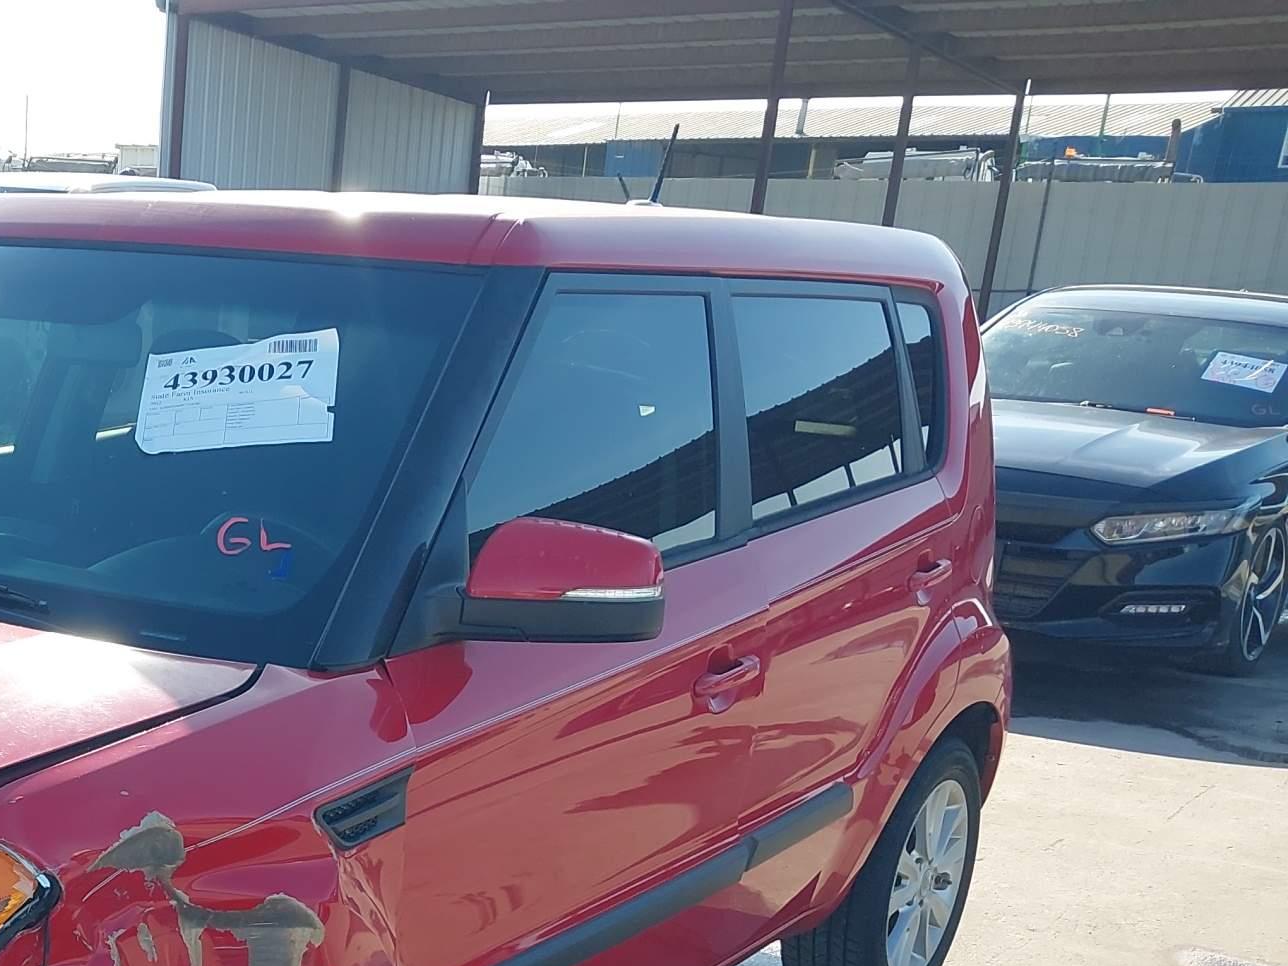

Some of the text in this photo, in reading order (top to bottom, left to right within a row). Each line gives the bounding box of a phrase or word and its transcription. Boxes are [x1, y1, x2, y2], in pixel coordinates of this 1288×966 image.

[163, 359, 314, 391] 43930027
[1251, 403, 1281, 416] GL
[217, 517, 292, 555] GL
